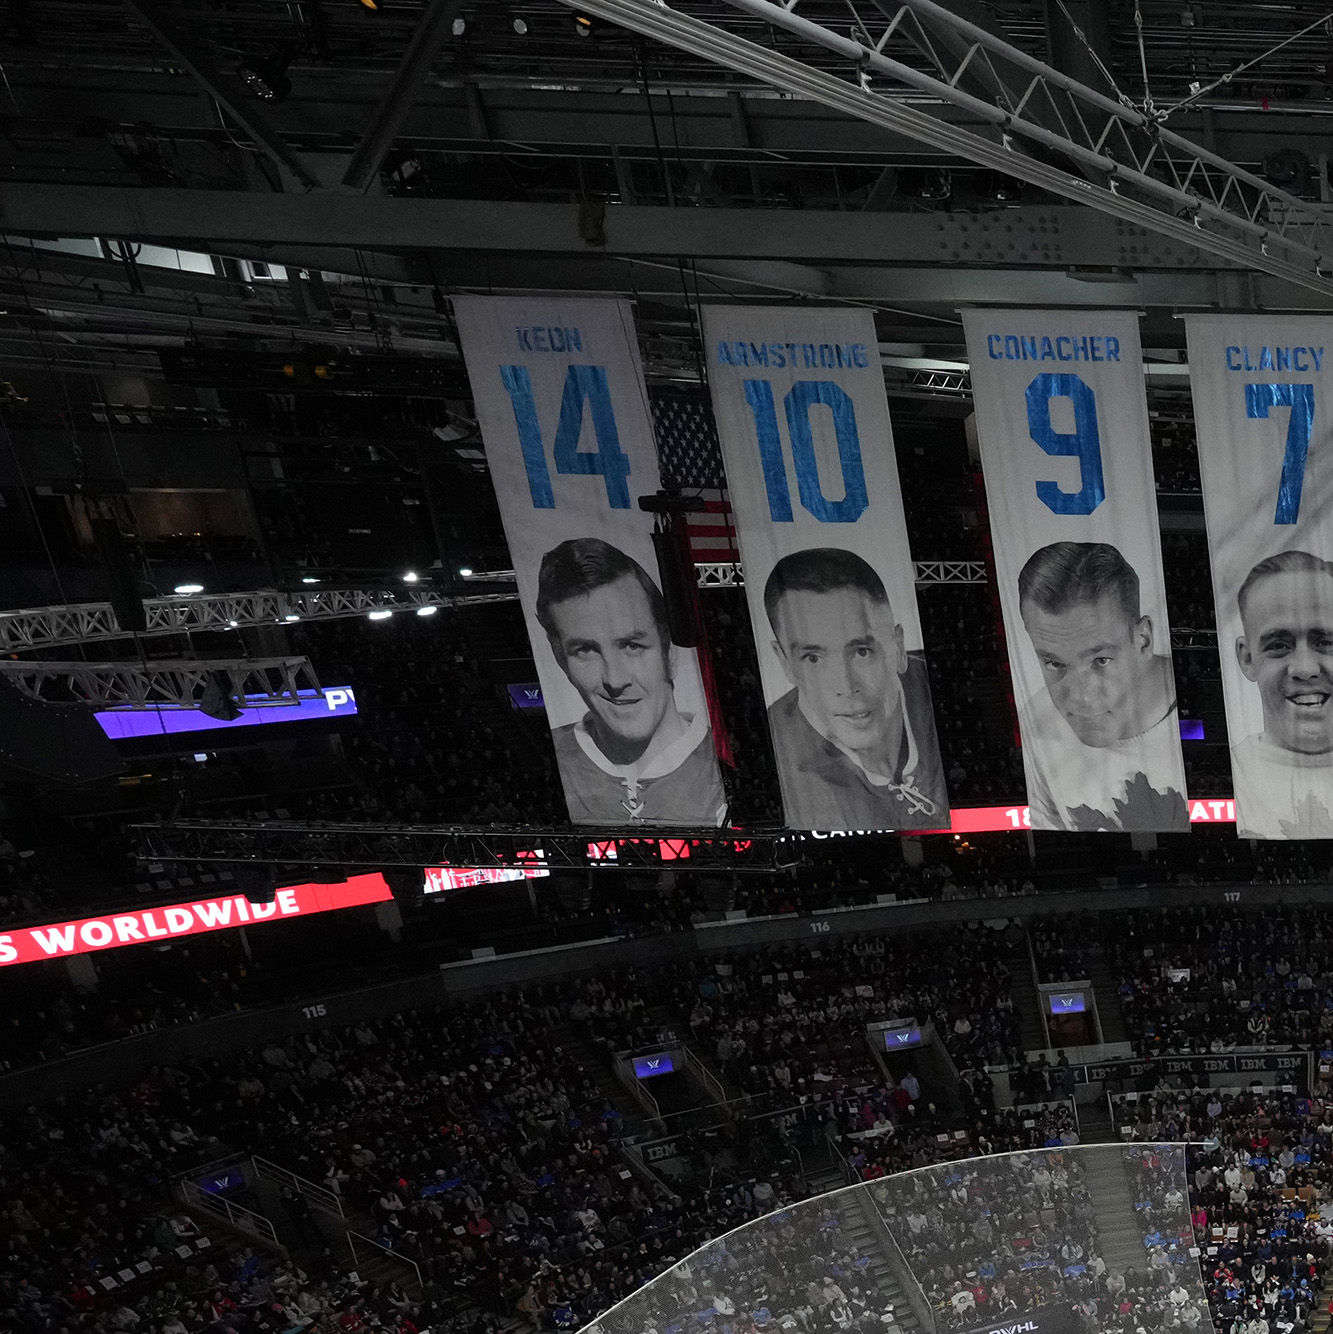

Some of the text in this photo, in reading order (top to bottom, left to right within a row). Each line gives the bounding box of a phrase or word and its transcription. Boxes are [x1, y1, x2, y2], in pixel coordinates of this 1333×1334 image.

[515, 326, 583, 353] KEON
[987, 334, 1121, 362] CONACHER
[717, 341, 869, 369] ARMSTRONG
[1226, 346, 1325, 373] CLANCY
[500, 365, 632, 509] 14
[1025, 372, 1106, 516] 9
[743, 379, 870, 523] 10
[1244, 383, 1315, 525] 7
[1224, 892, 1241, 903] 117
[30, 888, 301, 955] WORLDWIDE
[302, 1003, 327, 1019] 115
[1167, 1061, 1193, 1072] IBM
[1204, 1060, 1229, 1071] IBM
[1240, 1058, 1266, 1070] IBM
[1277, 1057, 1302, 1068] IBM
[647, 1142, 678, 1161] IBM
